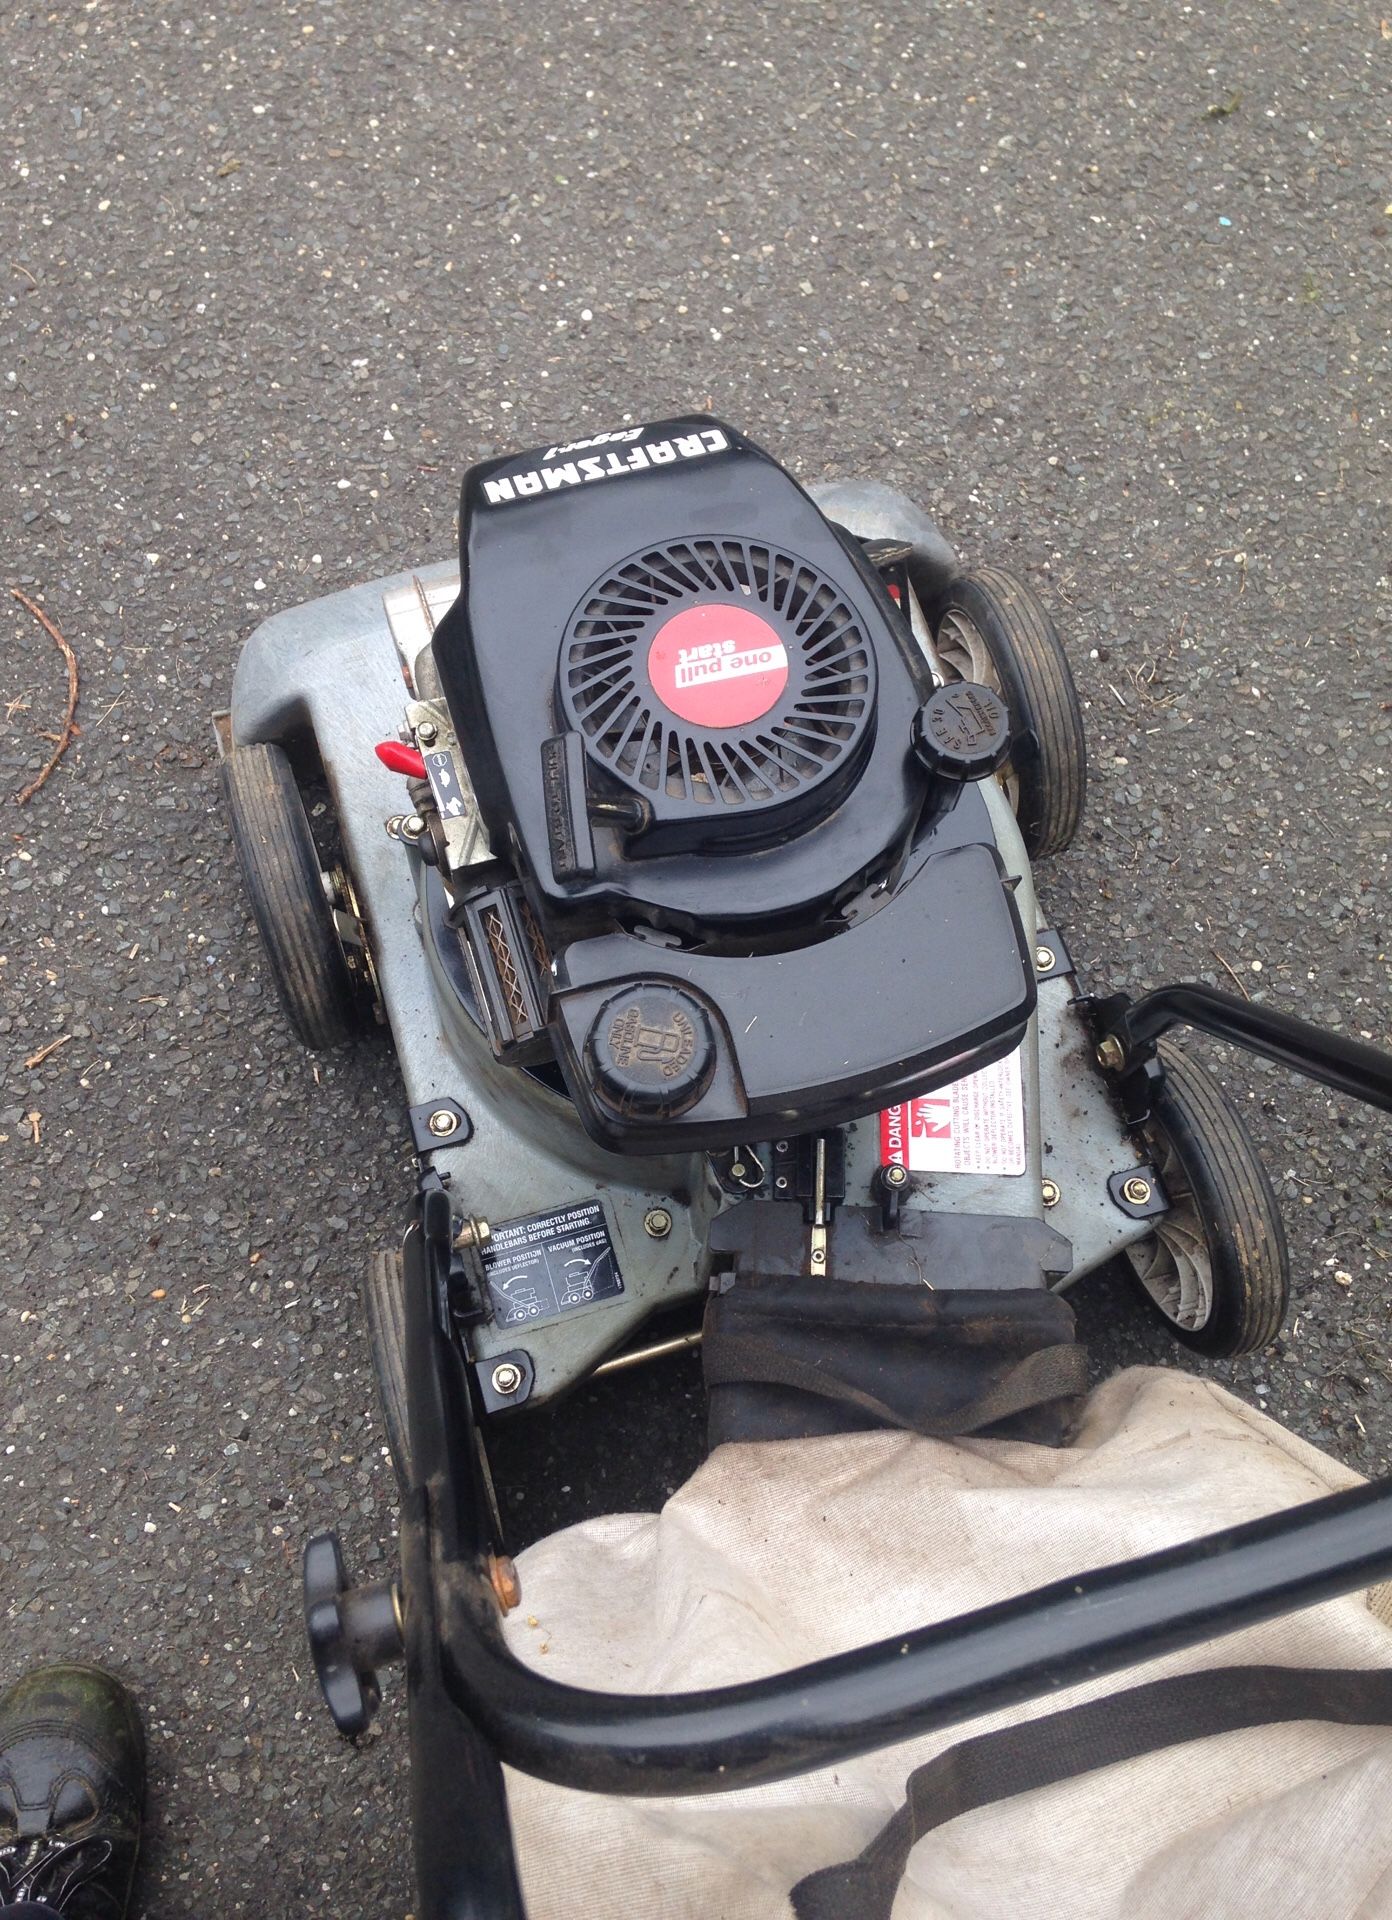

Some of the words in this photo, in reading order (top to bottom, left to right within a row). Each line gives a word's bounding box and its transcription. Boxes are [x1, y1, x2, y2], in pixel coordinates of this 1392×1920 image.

[483, 429, 728, 503] CRAFTSMAN
[677, 639, 737, 664] start
[729, 651, 772, 669] one
[678, 657, 723, 682] pull
[609, 1018, 624, 1049] ONLY
[617, 1008, 639, 1065] GASOLINE
[663, 1012, 693, 1076] UNLEADED
[961, 1093, 969, 1114] CAUSE
[888, 1105, 903, 1148] DANG
[952, 1105, 960, 1133] CUTTING
[953, 1136, 961, 1168] ROTATING
[491, 1225, 526, 1242] ORTANT:
[526, 1214, 566, 1232] CORRECTLY
[566, 1204, 599, 1220] POSITION
[480, 1235, 527, 1255] HANDLEBARS
[527, 1227, 555, 1241] BEFORE
[547, 1239, 575, 1252] VACUUM
[575, 1230, 605, 1244] POSITION
[484, 1257, 511, 1270] BLOWER
[512, 1249, 541, 1263] POSITION
